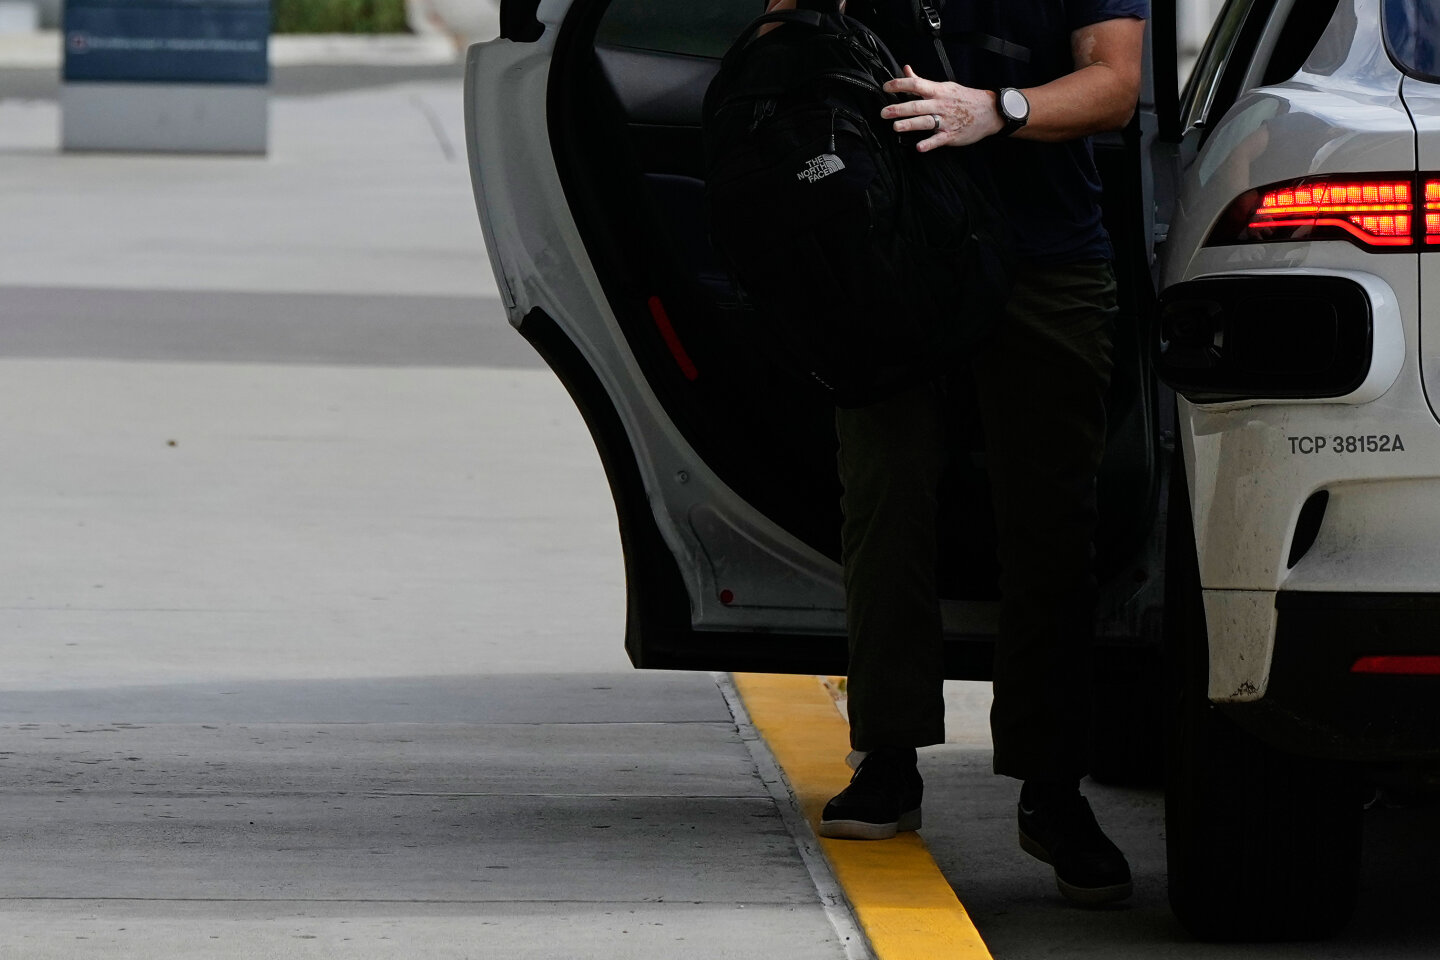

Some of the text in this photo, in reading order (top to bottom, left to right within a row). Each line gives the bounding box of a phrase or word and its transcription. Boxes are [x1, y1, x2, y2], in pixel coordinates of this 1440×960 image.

[805, 155, 824, 167] THE
[796, 162, 828, 180] NORTH
[808, 168, 830, 183] FACE
[1288, 435, 1405, 454] TCP 38152A
